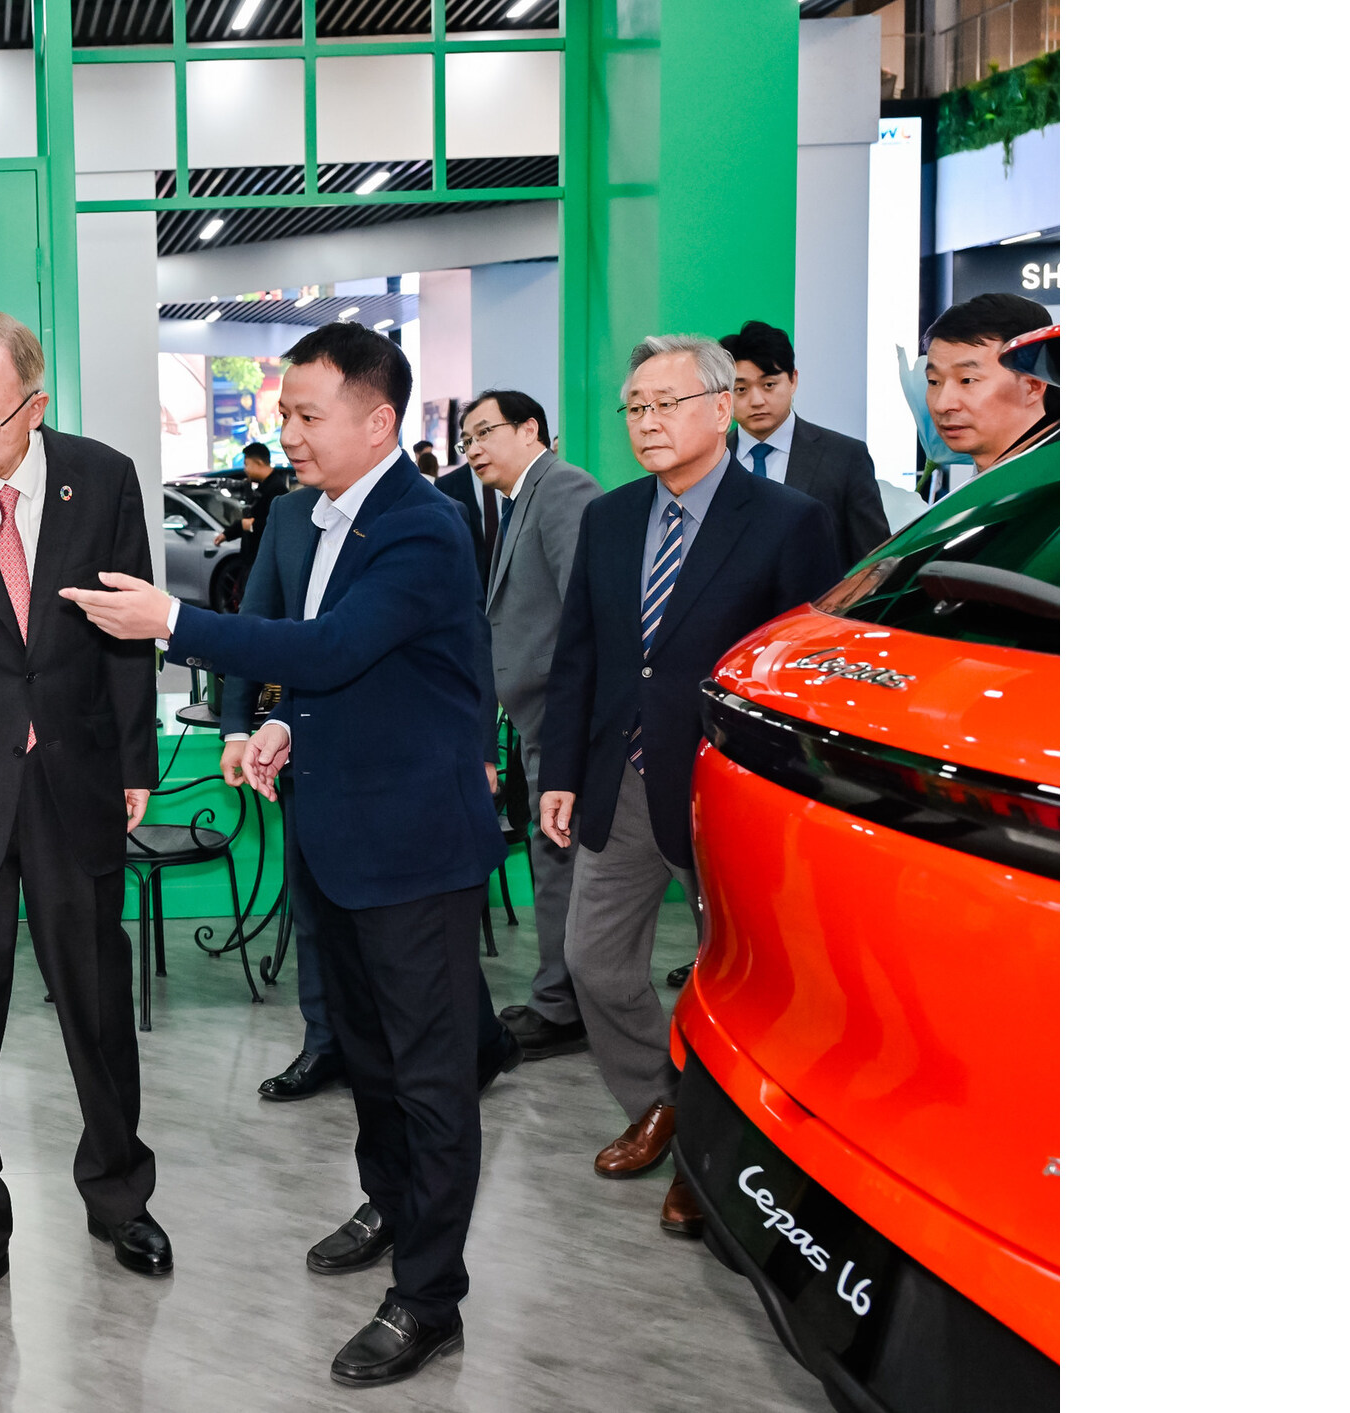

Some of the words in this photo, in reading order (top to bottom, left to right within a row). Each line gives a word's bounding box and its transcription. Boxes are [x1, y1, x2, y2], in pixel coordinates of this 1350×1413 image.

[795, 646, 916, 688] Lepas
[738, 1165, 831, 1273] Lepas
[836, 1260, 873, 1316] L6
